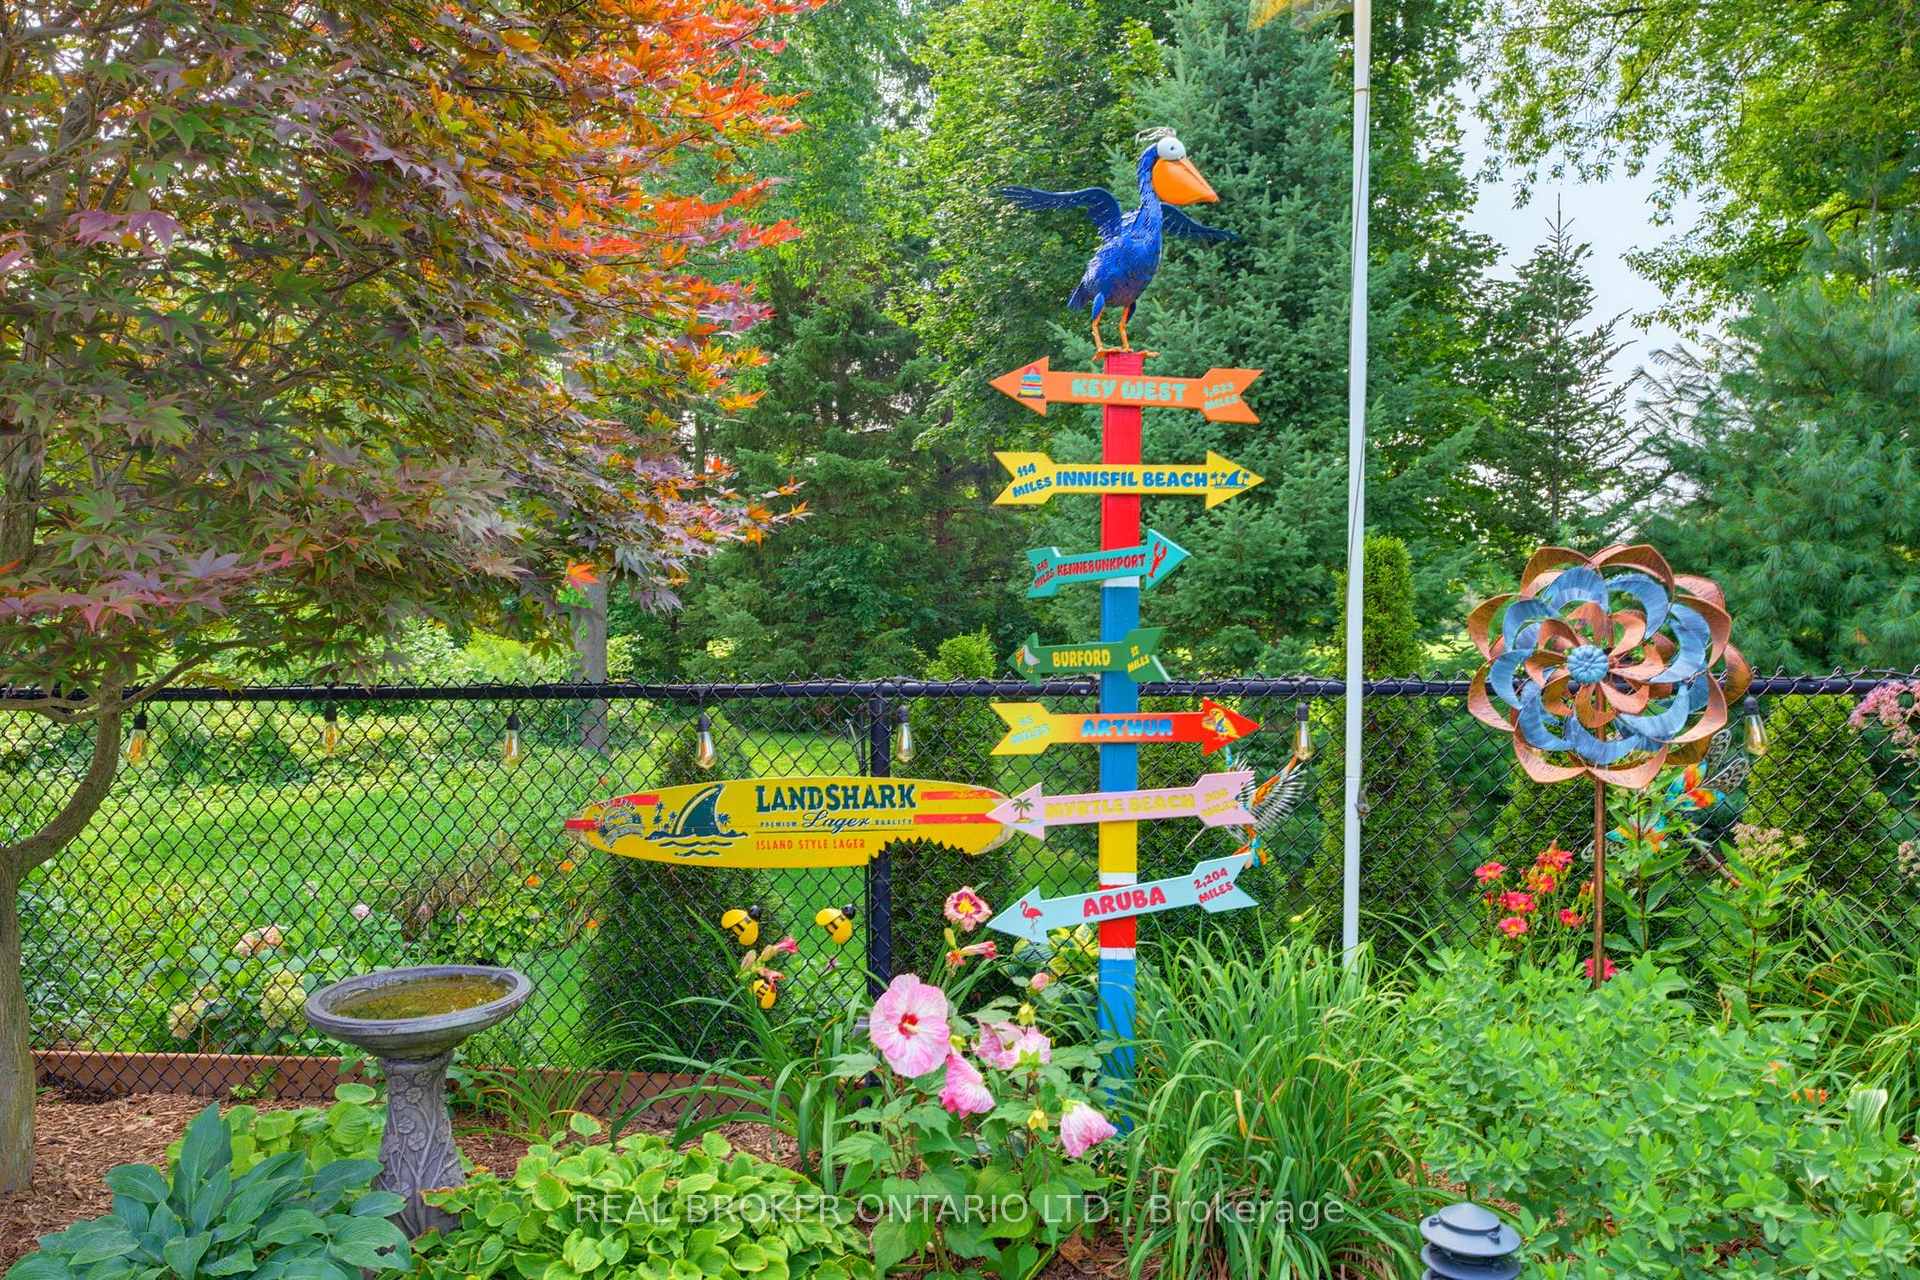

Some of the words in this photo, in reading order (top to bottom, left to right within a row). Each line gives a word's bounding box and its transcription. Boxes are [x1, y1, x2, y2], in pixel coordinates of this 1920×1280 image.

[1071, 378, 1117, 398] KEY
[1121, 381, 1187, 401] WEST
[1012, 476, 1051, 498] MILES
[1055, 471, 1138, 487] INNISFIL
[1142, 471, 1208, 487] BEACH
[1052, 649, 1110, 667] BURFORD
[1080, 719, 1173, 737] ARTHUR
[756, 784, 916, 812] LANDSHARK
[1044, 798, 1125, 819] MYRTLE
[1128, 793, 1196, 815] BEACH
[803, 809, 869, 835] Lager
[756, 840, 793, 850] ISLAND
[799, 839, 828, 849] STYLE
[833, 838, 865, 849] LAGER
[1193, 867, 1229, 889] 2,204
[1083, 886, 1167, 917] ARUBA
[1199, 881, 1235, 904] MILES
